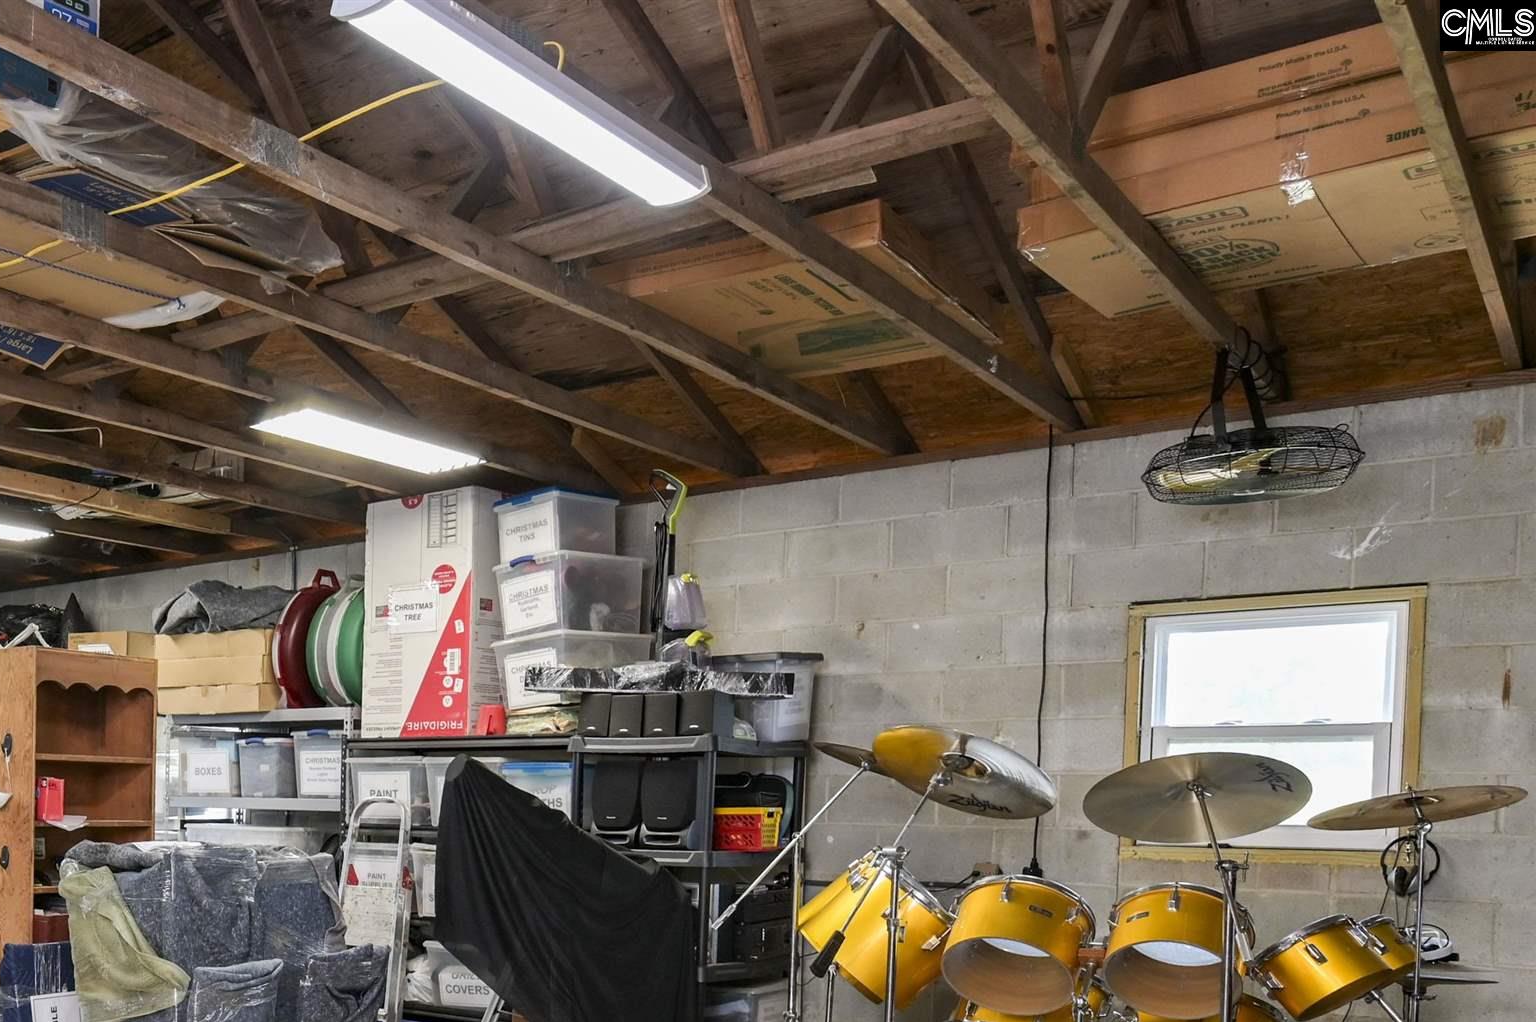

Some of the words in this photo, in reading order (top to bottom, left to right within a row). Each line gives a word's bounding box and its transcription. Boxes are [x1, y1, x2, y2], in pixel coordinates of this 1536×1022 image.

[6, 332, 34, 354] Large
[505, 518, 549, 537] CHRISTMAS
[519, 532, 536, 543] TINS
[508, 583, 550, 601] CHRISTMAS
[394, 601, 434, 612] CHRISTMAS
[403, 612, 422, 621] TREE
[407, 719, 464, 731] FRIGIDAIRE
[194, 766, 223, 776] BOXES
[369, 789, 399, 800] PAINT
[948, 791, 1014, 815] Zildjian
[367, 872, 386, 881] PAINT
[445, 984, 491, 996] COVERS
